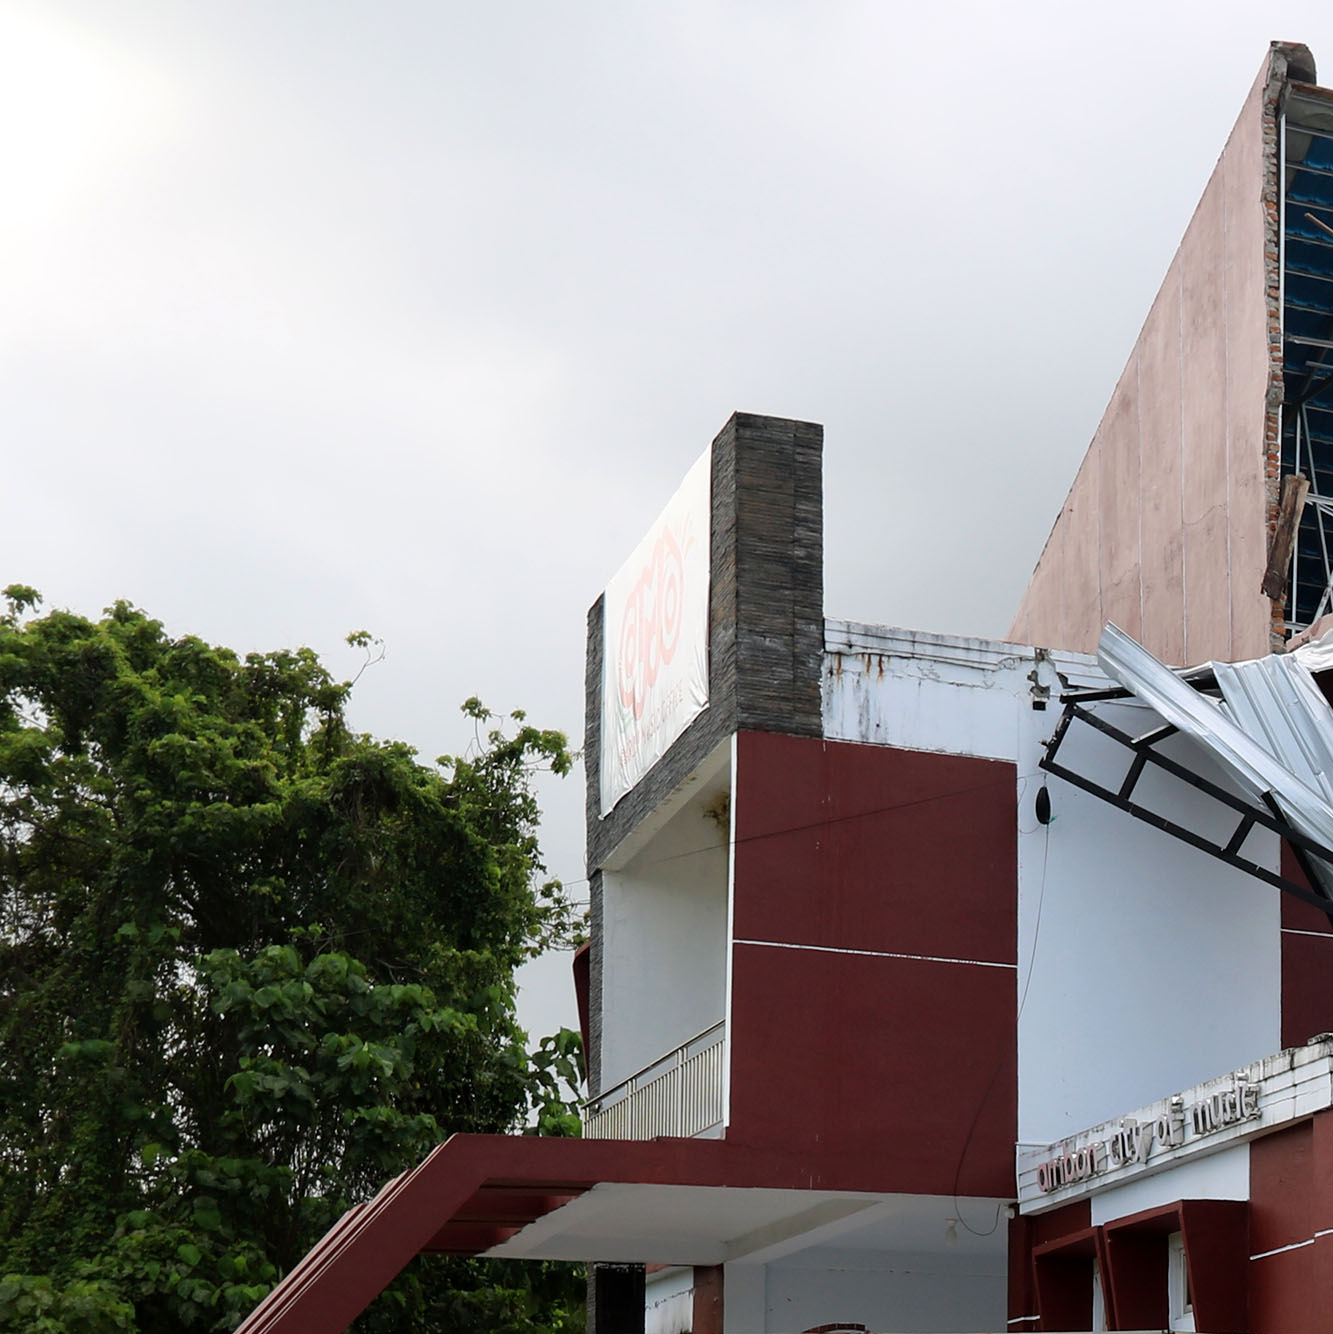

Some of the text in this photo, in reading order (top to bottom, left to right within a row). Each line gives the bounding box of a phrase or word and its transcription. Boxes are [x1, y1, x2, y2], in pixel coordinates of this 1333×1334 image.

[1037, 1073, 1260, 1192] ambon city of music
